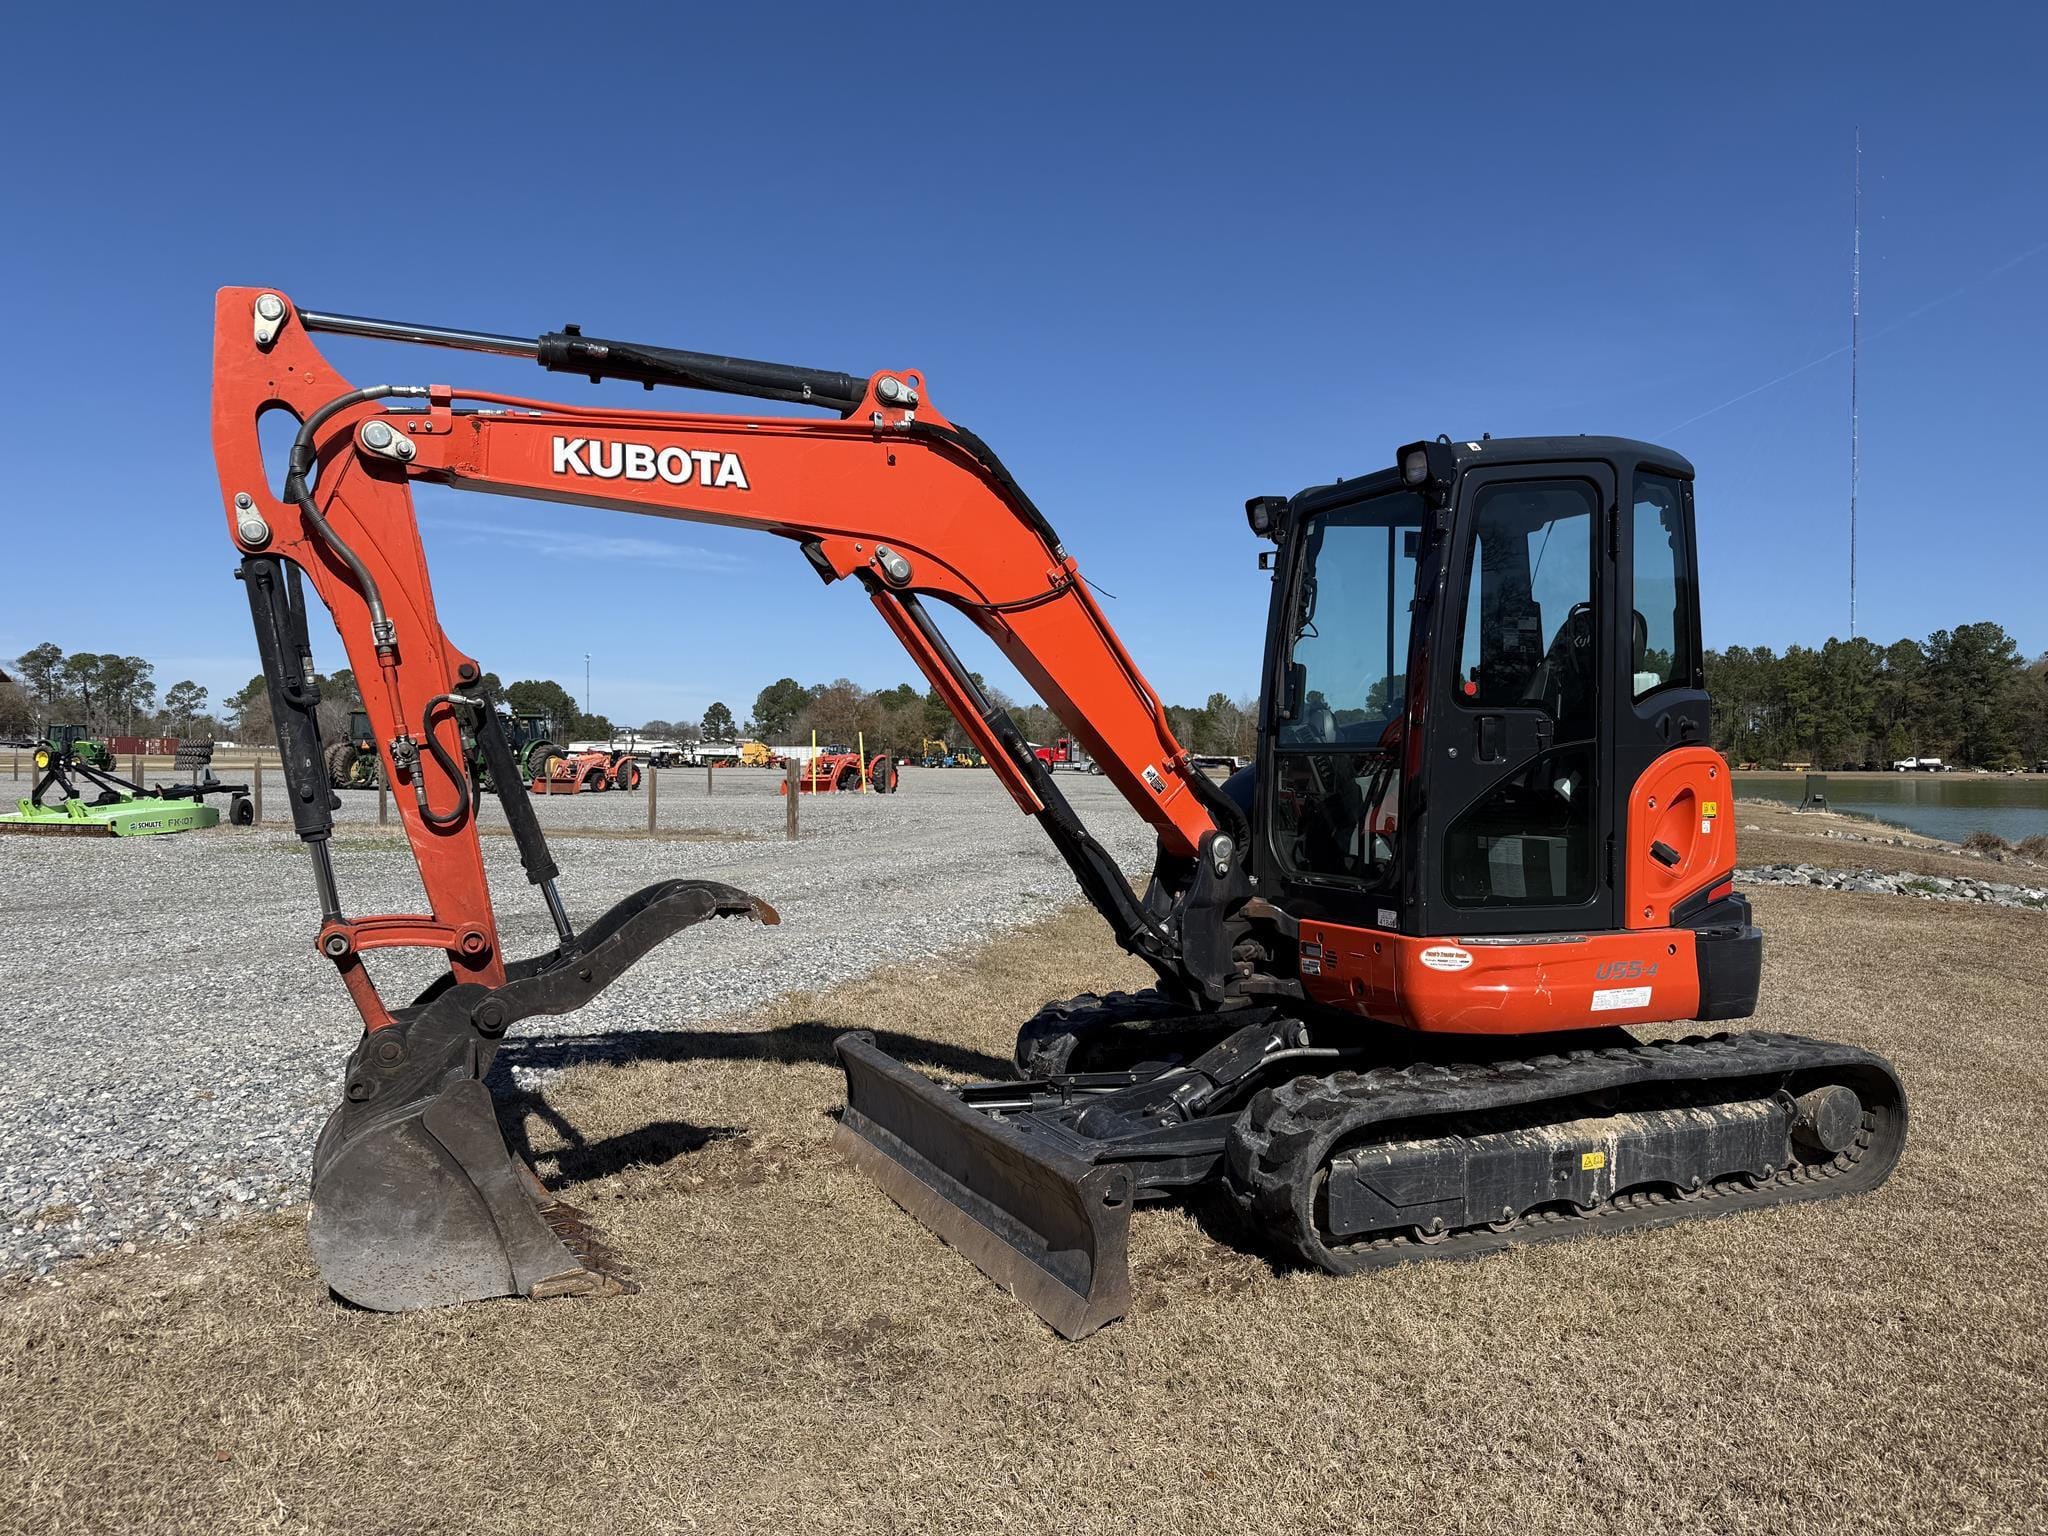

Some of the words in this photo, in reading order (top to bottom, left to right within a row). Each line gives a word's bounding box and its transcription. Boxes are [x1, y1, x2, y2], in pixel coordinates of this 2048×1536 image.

[552, 436, 749, 489] KUBOTA
[138, 820, 162, 829] SCHULTE
[1596, 960, 1659, 980] U55-4
